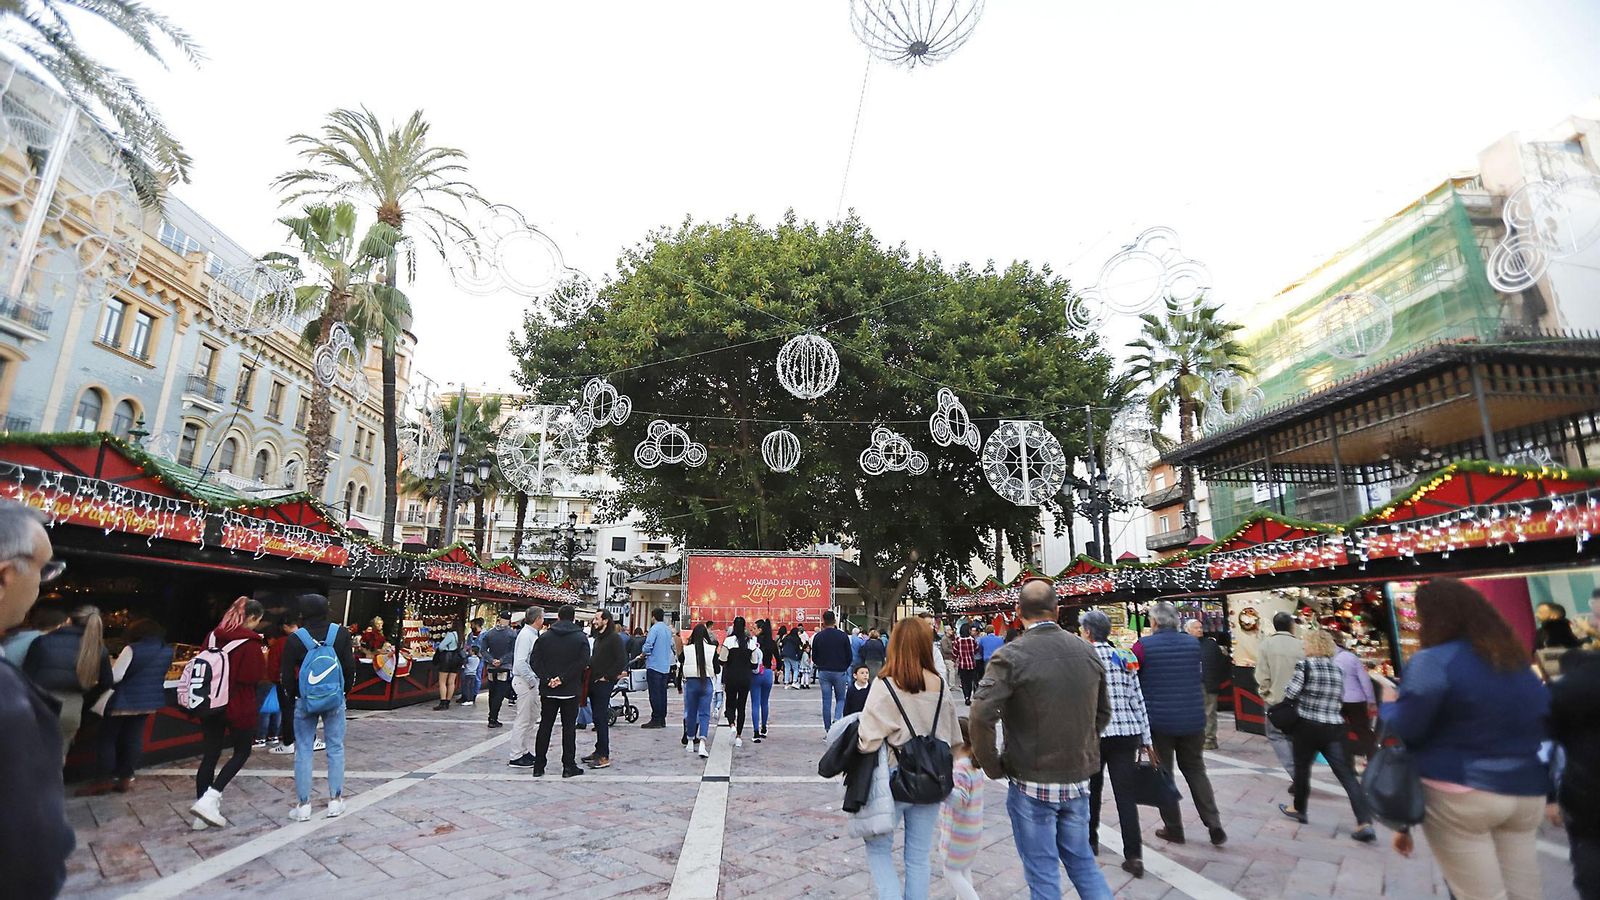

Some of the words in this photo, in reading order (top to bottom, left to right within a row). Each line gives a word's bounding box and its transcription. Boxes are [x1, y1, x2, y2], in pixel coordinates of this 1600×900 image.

[22, 490, 76, 515] Belnes
[742, 583, 763, 603] La
[762, 586, 777, 601] luz
[779, 586, 794, 597] del
[796, 584, 821, 599] Sur
[189, 663, 207, 708] FILA
